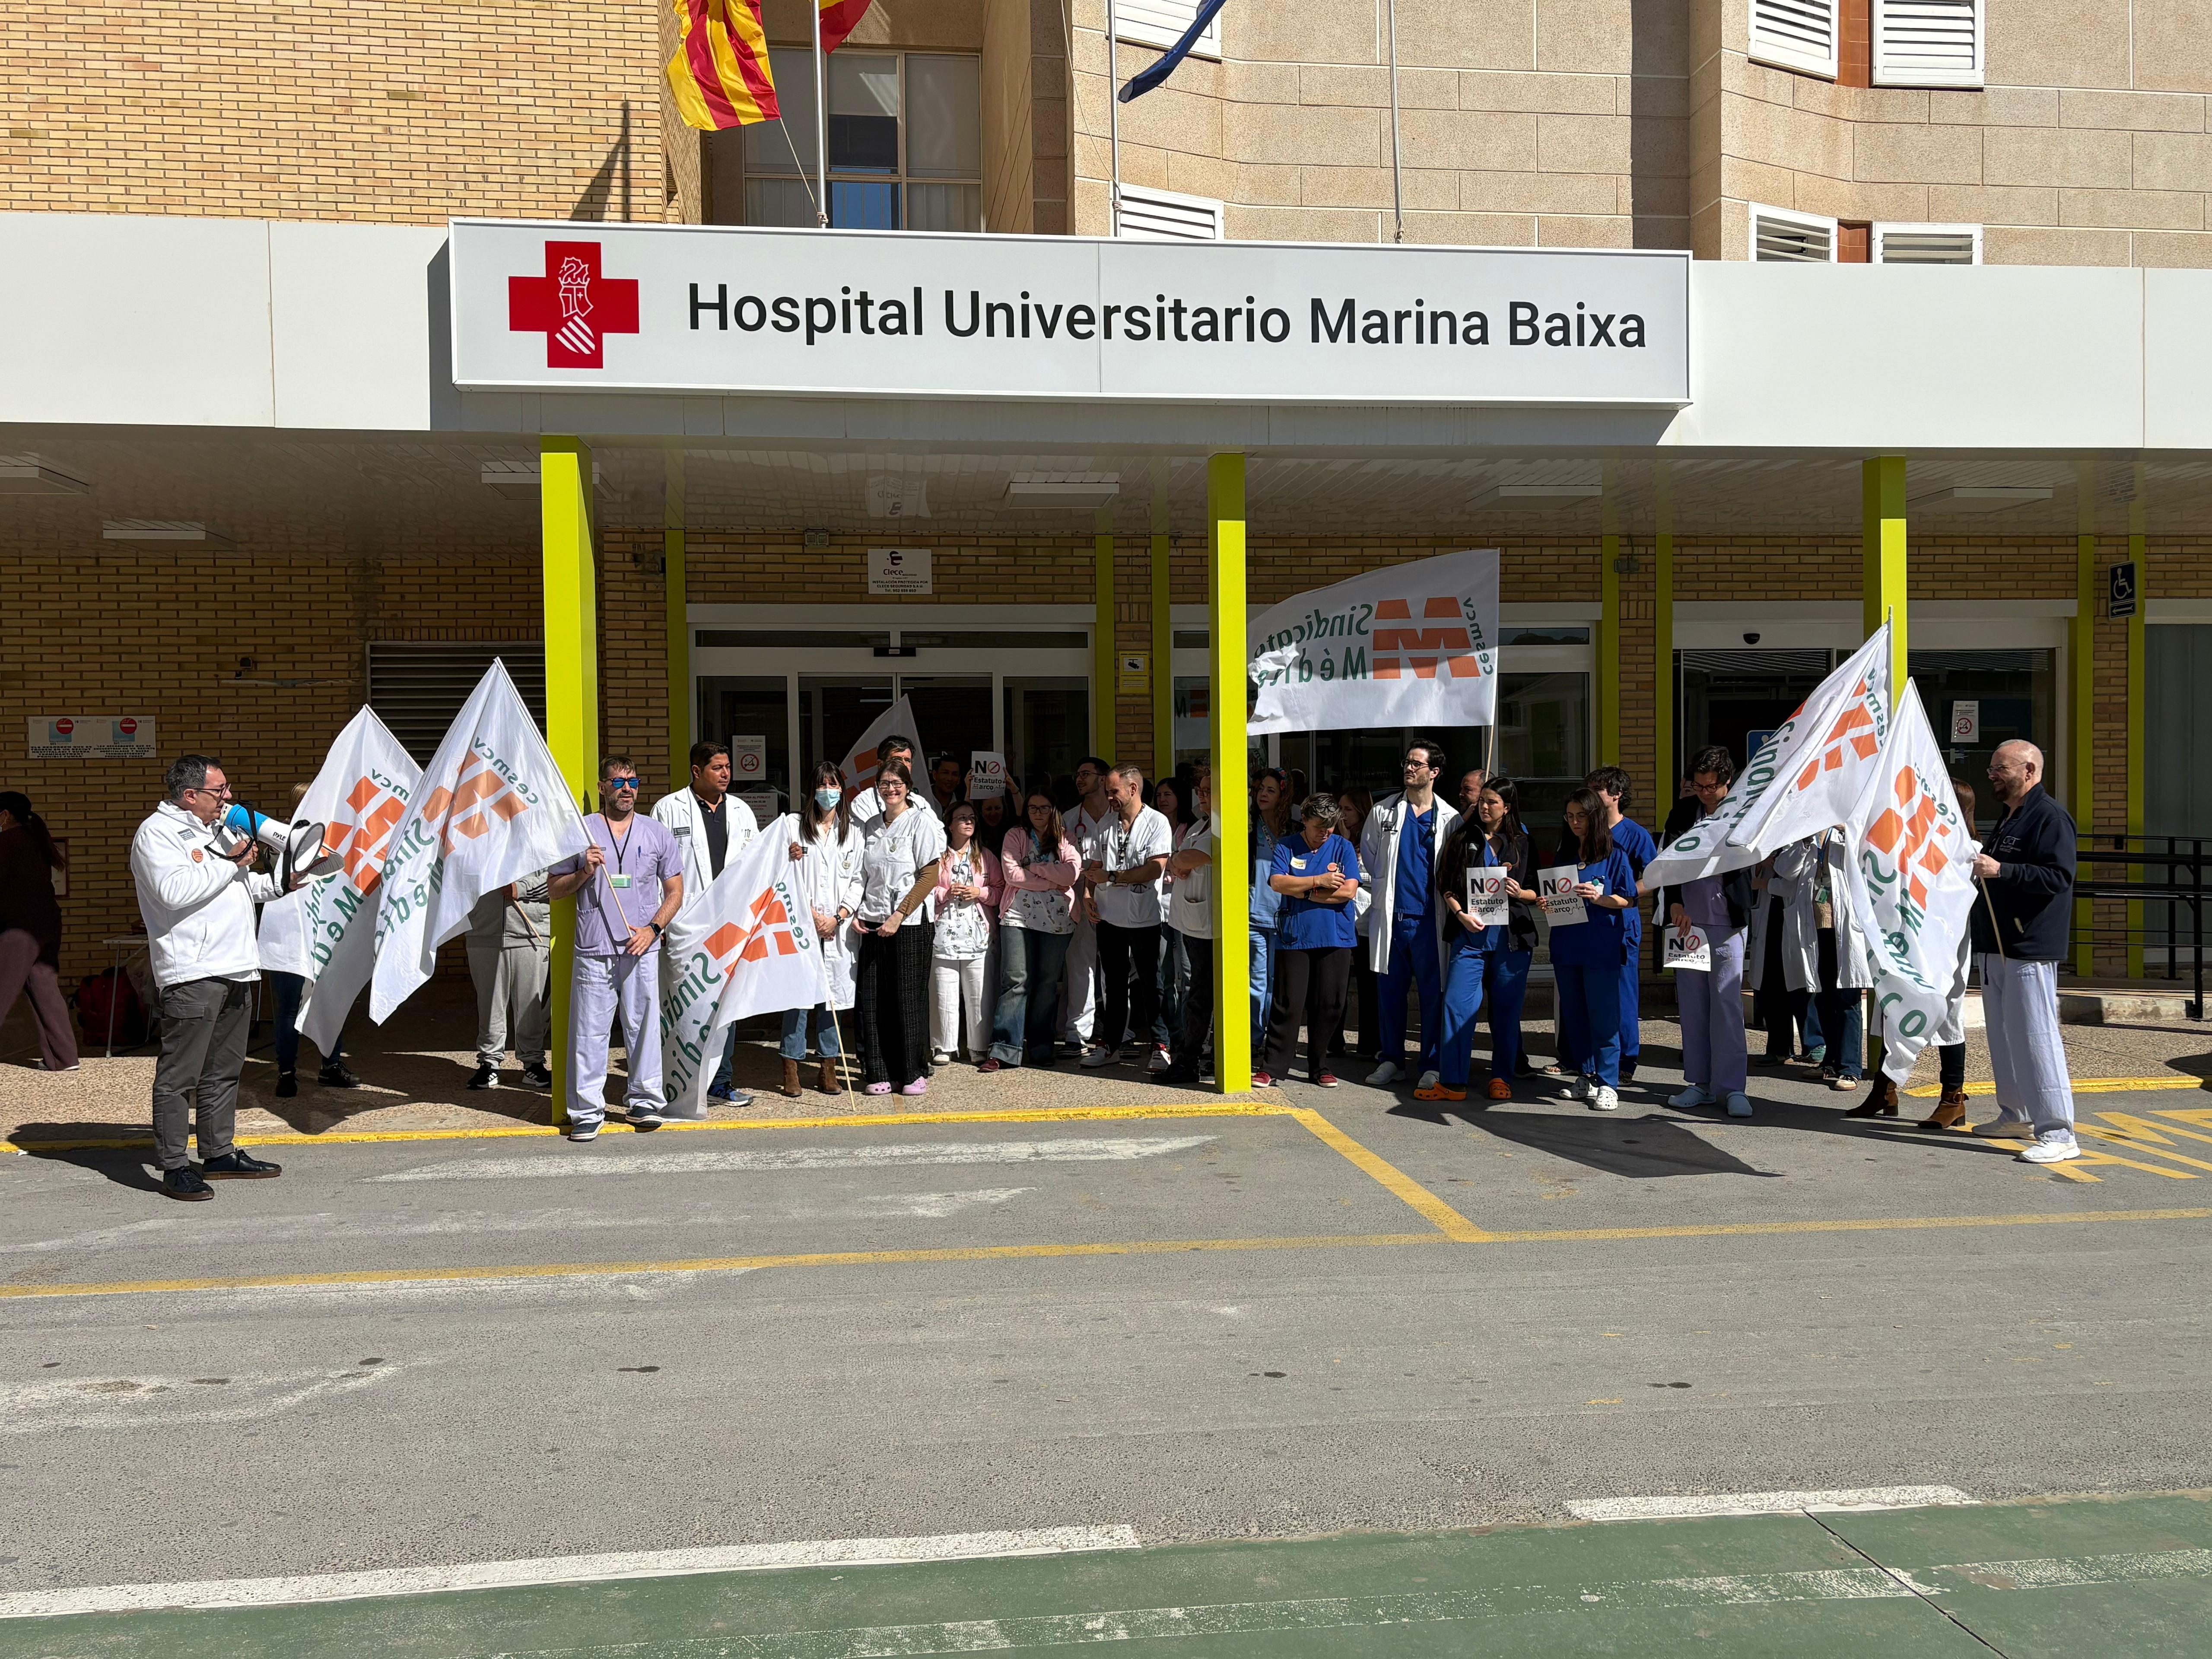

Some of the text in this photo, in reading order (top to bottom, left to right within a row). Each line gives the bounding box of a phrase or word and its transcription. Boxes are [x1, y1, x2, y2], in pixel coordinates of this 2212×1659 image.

[690, 283, 1646, 348] Hospital Universitario Marina Baixa
[1546, 897, 1578, 907] Estatuto
